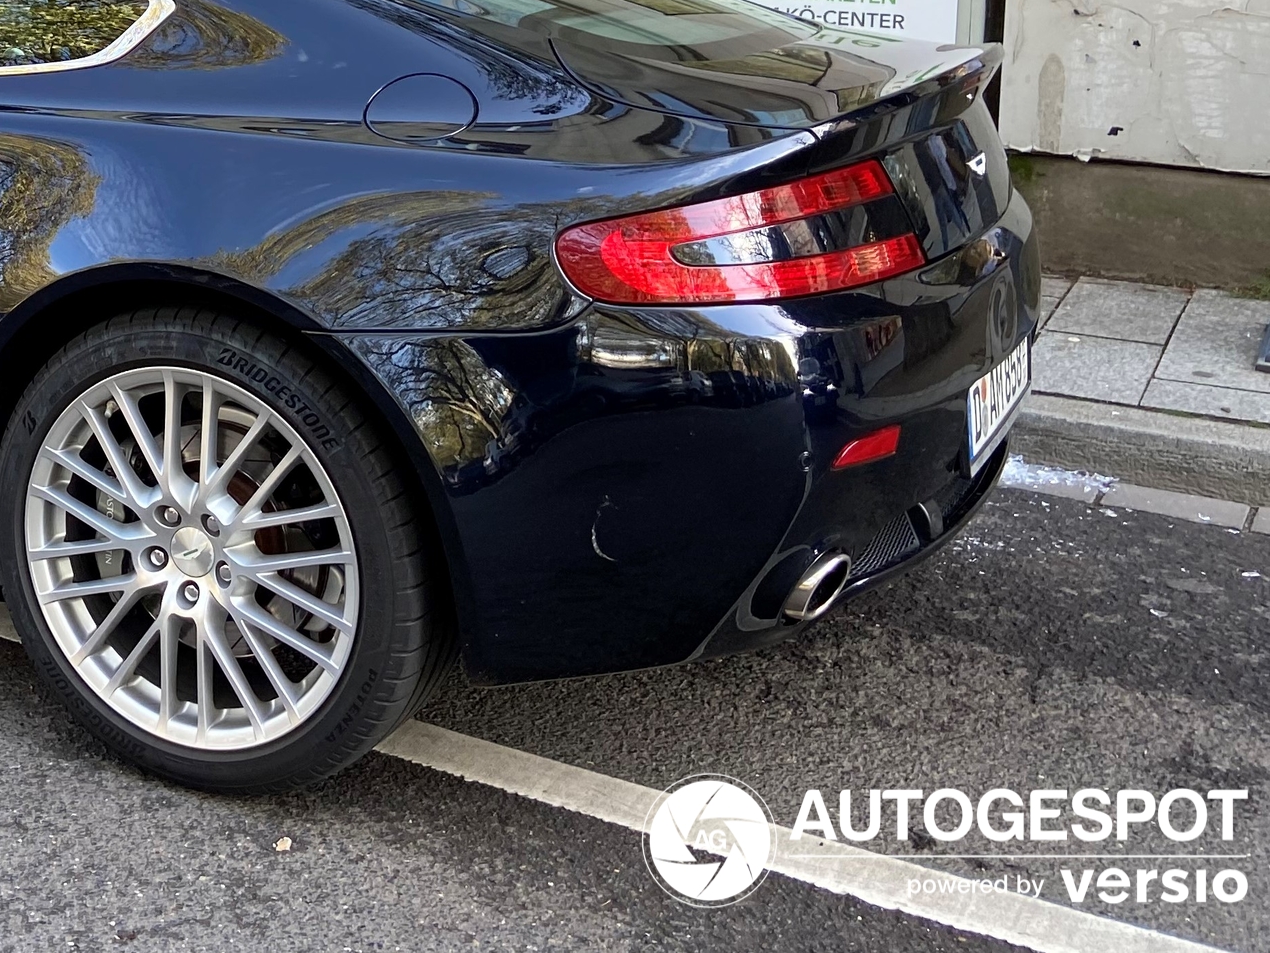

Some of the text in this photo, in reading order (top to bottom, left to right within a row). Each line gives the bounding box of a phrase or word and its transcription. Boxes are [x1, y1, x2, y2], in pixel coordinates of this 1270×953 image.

[217, 348, 339, 450] BRIDGESTONE
[973, 386, 982, 444] D
[106, 495, 114, 520] ASTO
[325, 668, 378, 742] POTENZA
